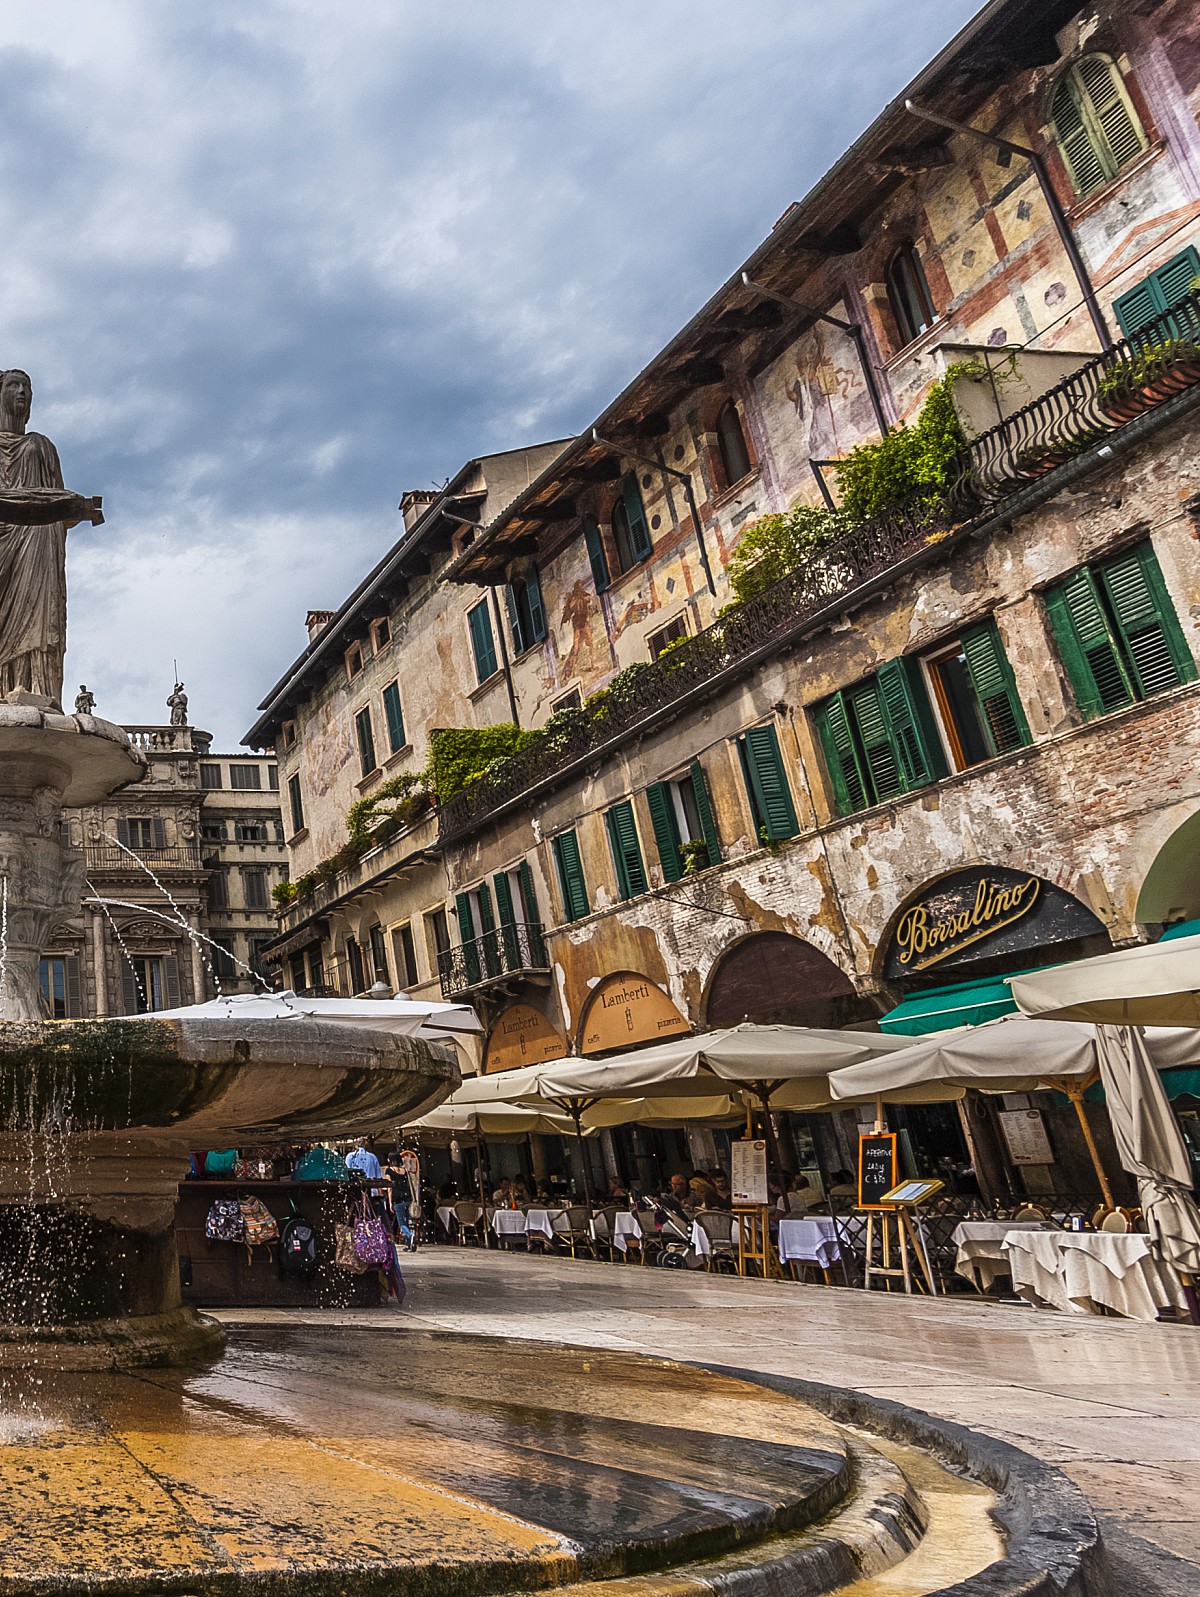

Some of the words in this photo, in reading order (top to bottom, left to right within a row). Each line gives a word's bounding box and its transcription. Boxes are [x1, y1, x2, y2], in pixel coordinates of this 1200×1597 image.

[896, 877, 1040, 970] Borsalino
[600, 983, 650, 1008] Lamberti
[502, 1014, 539, 1035] Lamberti
[657, 1016, 682, 1030] pizzeria
